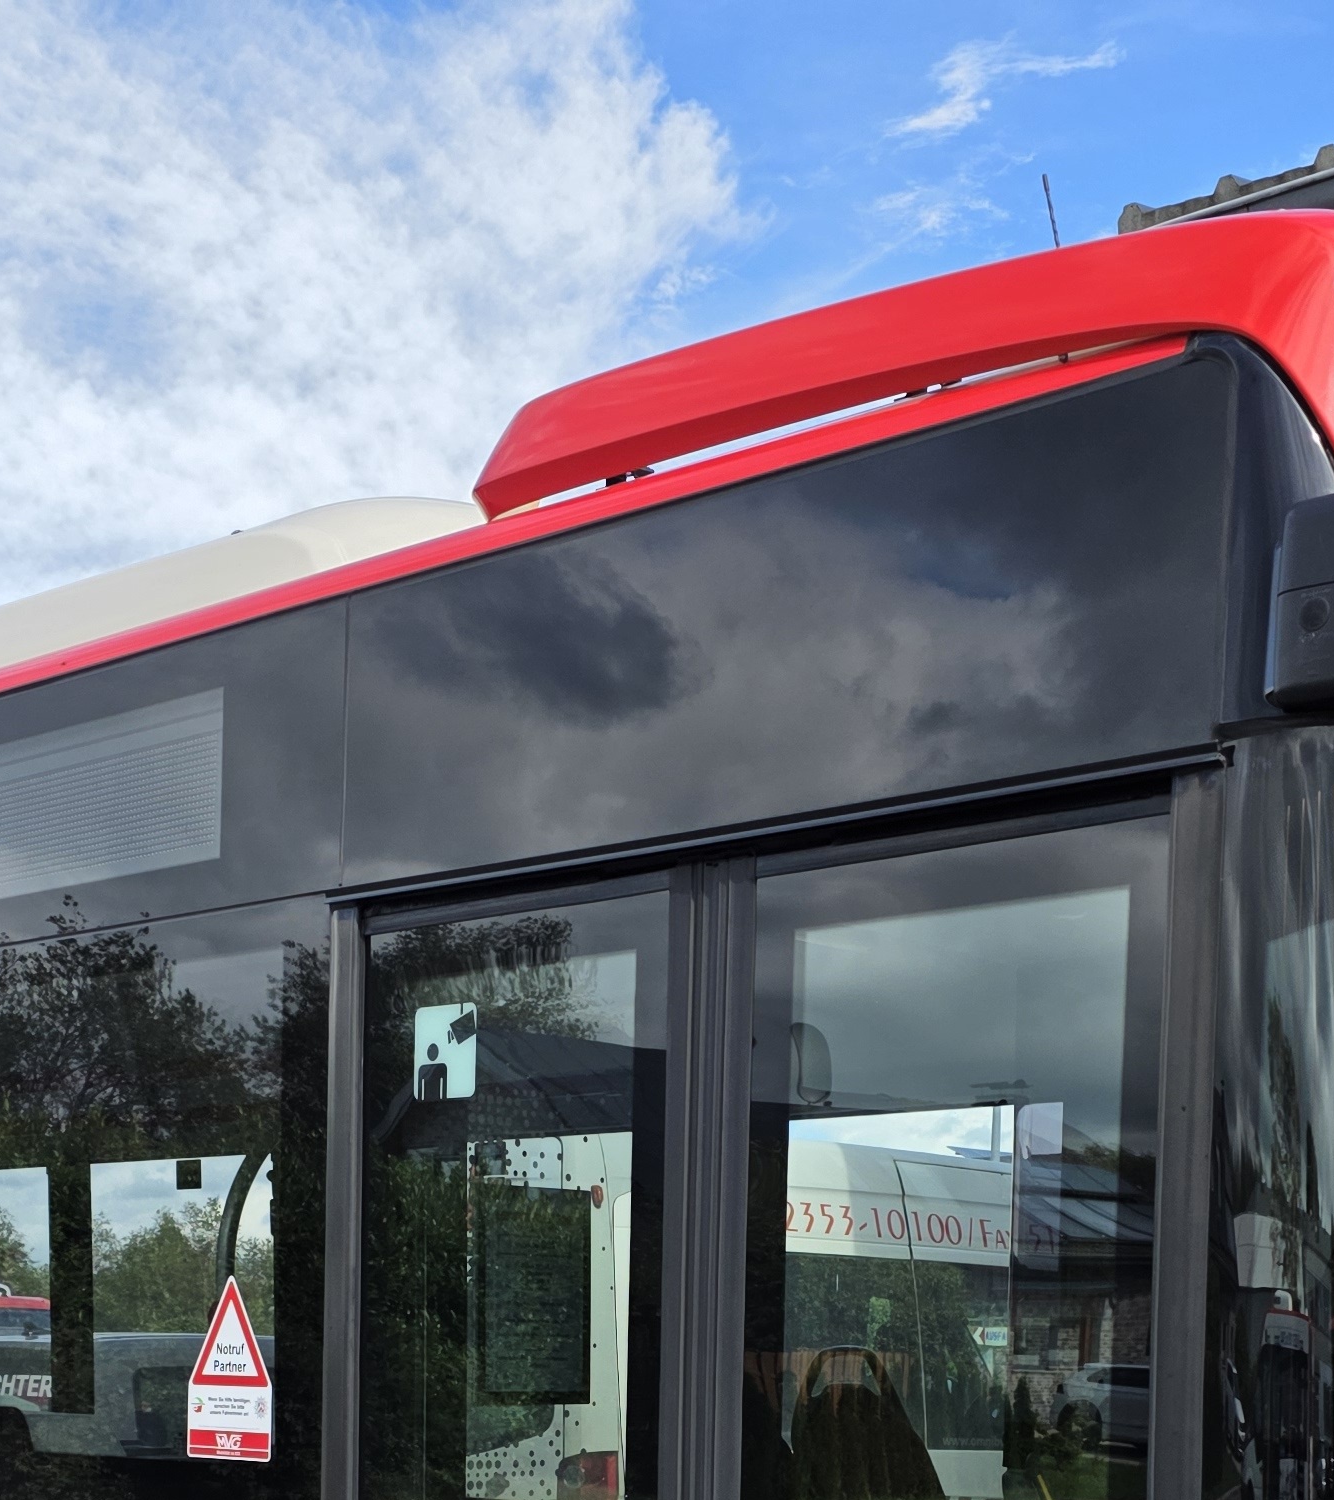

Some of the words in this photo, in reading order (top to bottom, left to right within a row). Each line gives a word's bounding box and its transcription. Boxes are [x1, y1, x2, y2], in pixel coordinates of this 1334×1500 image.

[217, 1343, 245, 1355] Notruf
[214, 1360, 246, 1373] Partner
[215, 1433, 243, 1448] MVG
